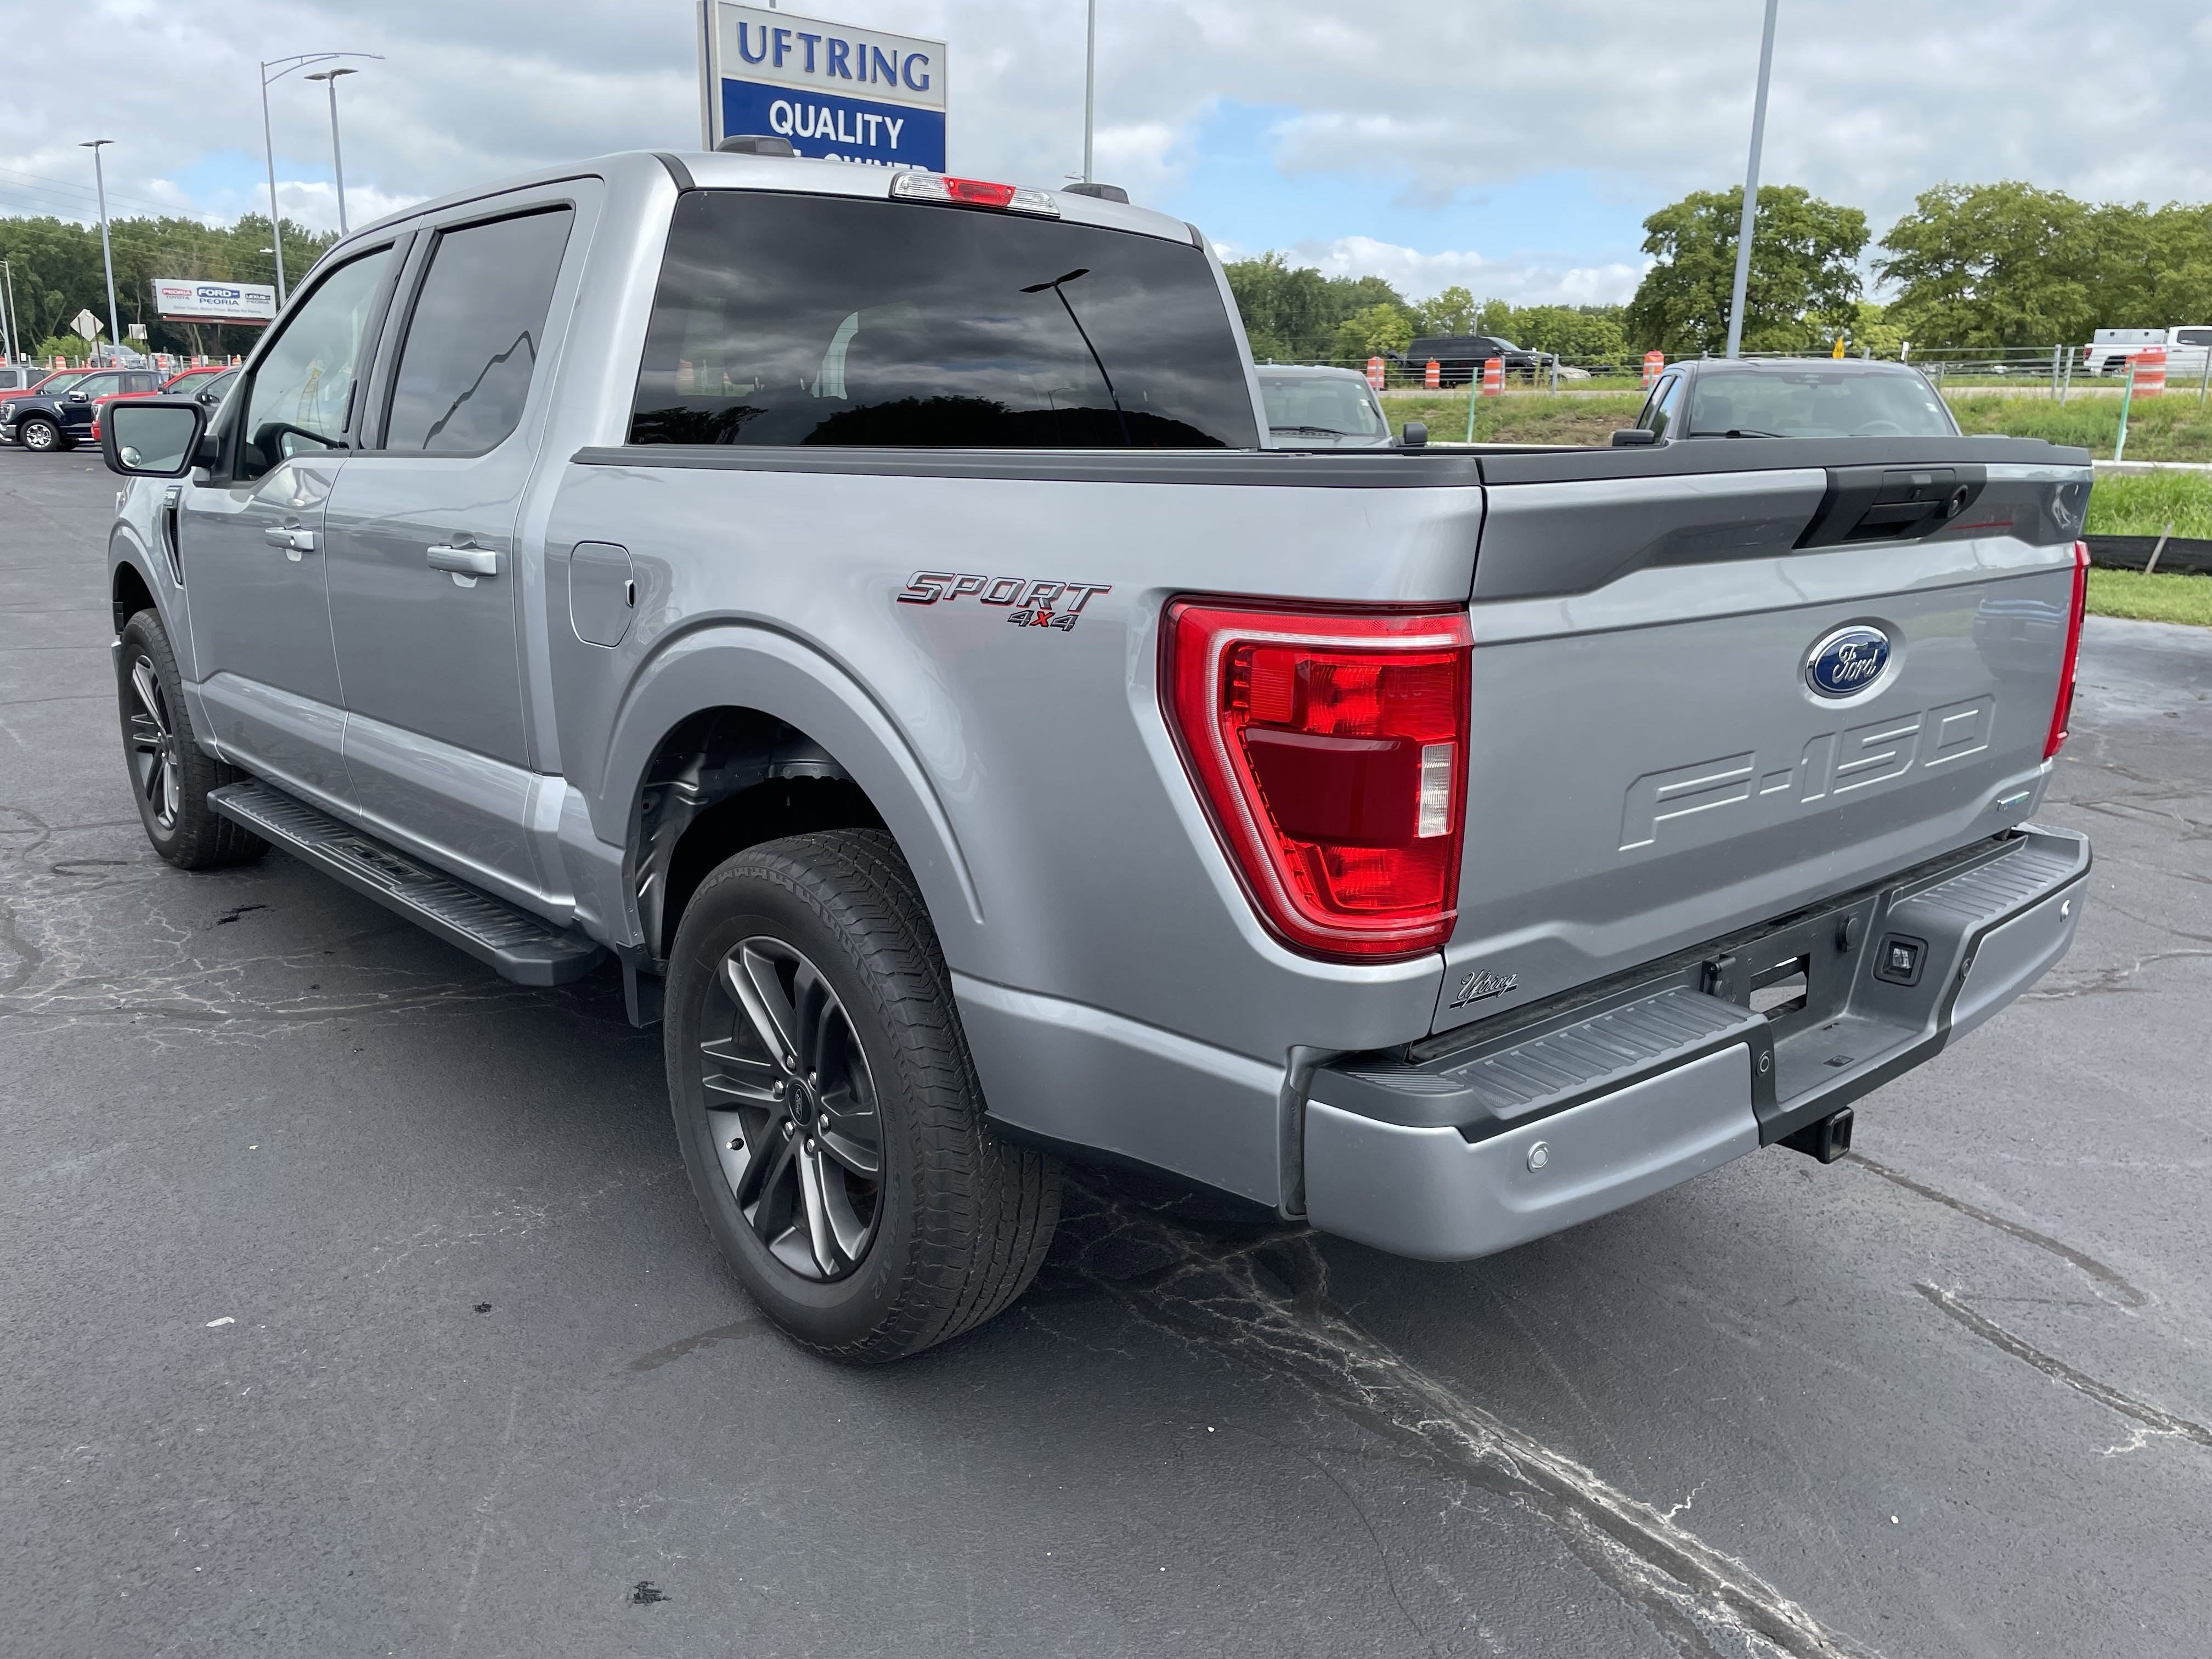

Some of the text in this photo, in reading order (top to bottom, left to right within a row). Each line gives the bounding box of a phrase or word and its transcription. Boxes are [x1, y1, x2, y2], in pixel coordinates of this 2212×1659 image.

[737, 22, 930, 92] UFTRING
[769, 100, 904, 149] QUALITY
[198, 289, 232, 297] FORD
[896, 570, 1114, 613] SPORT
[1832, 641, 1879, 684] Ford
[1618, 693, 1996, 851] F-150
